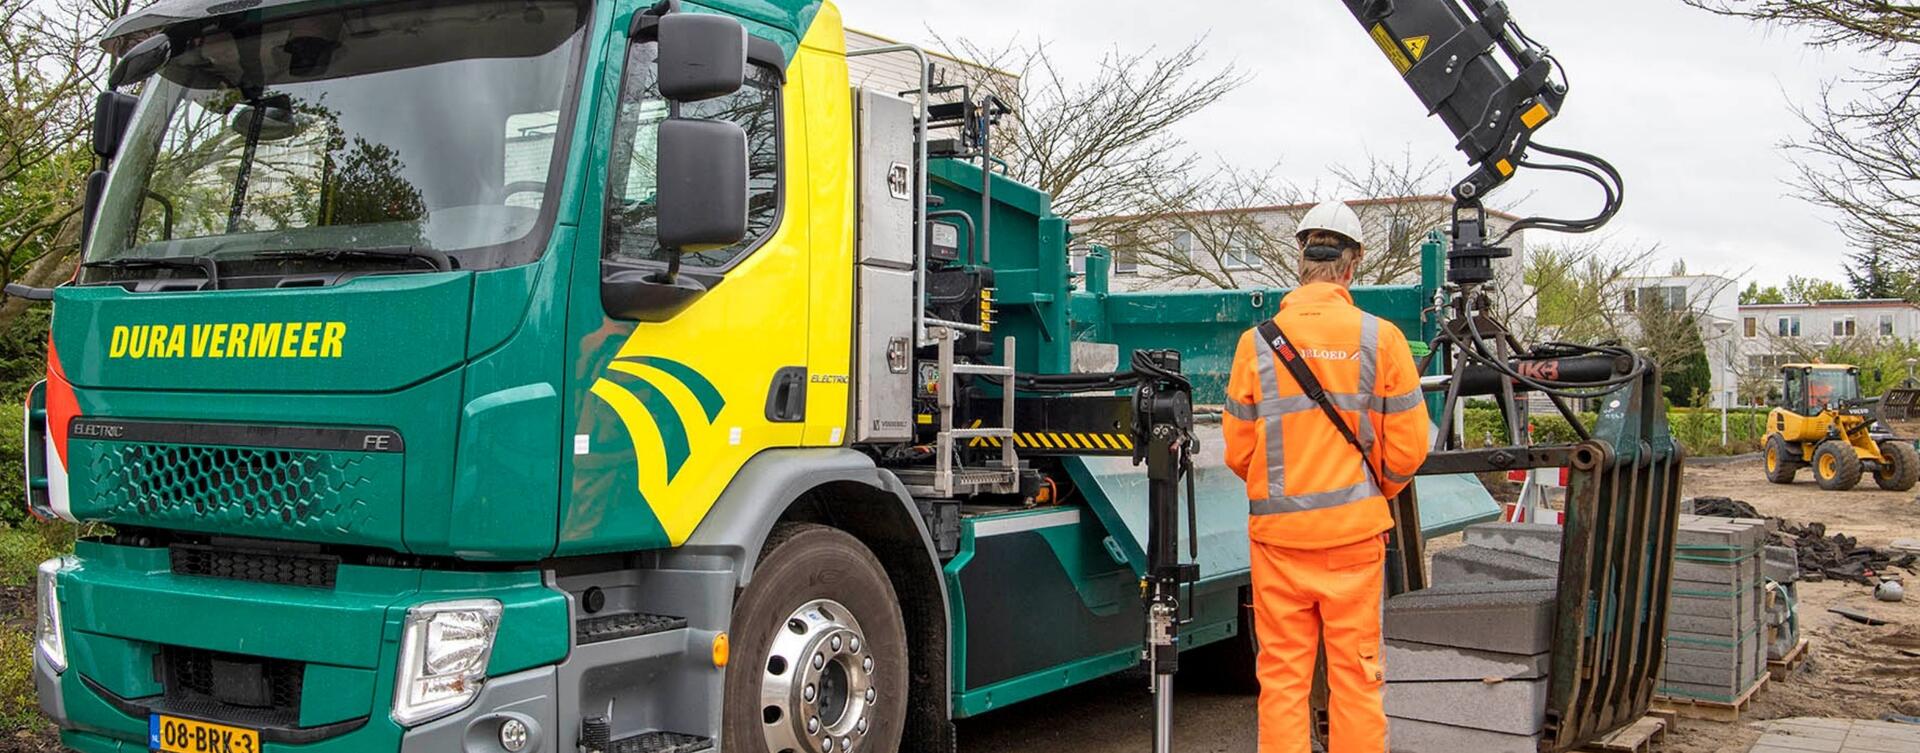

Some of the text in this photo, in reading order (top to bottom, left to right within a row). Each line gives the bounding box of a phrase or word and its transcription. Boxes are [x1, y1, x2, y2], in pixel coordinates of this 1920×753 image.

[109, 321, 347, 359] DURA VERMEER
[74, 423, 124, 438] ELECTRIC
[362, 434, 391, 450] FE
[164, 720, 253, 753] 08-BRK-3
